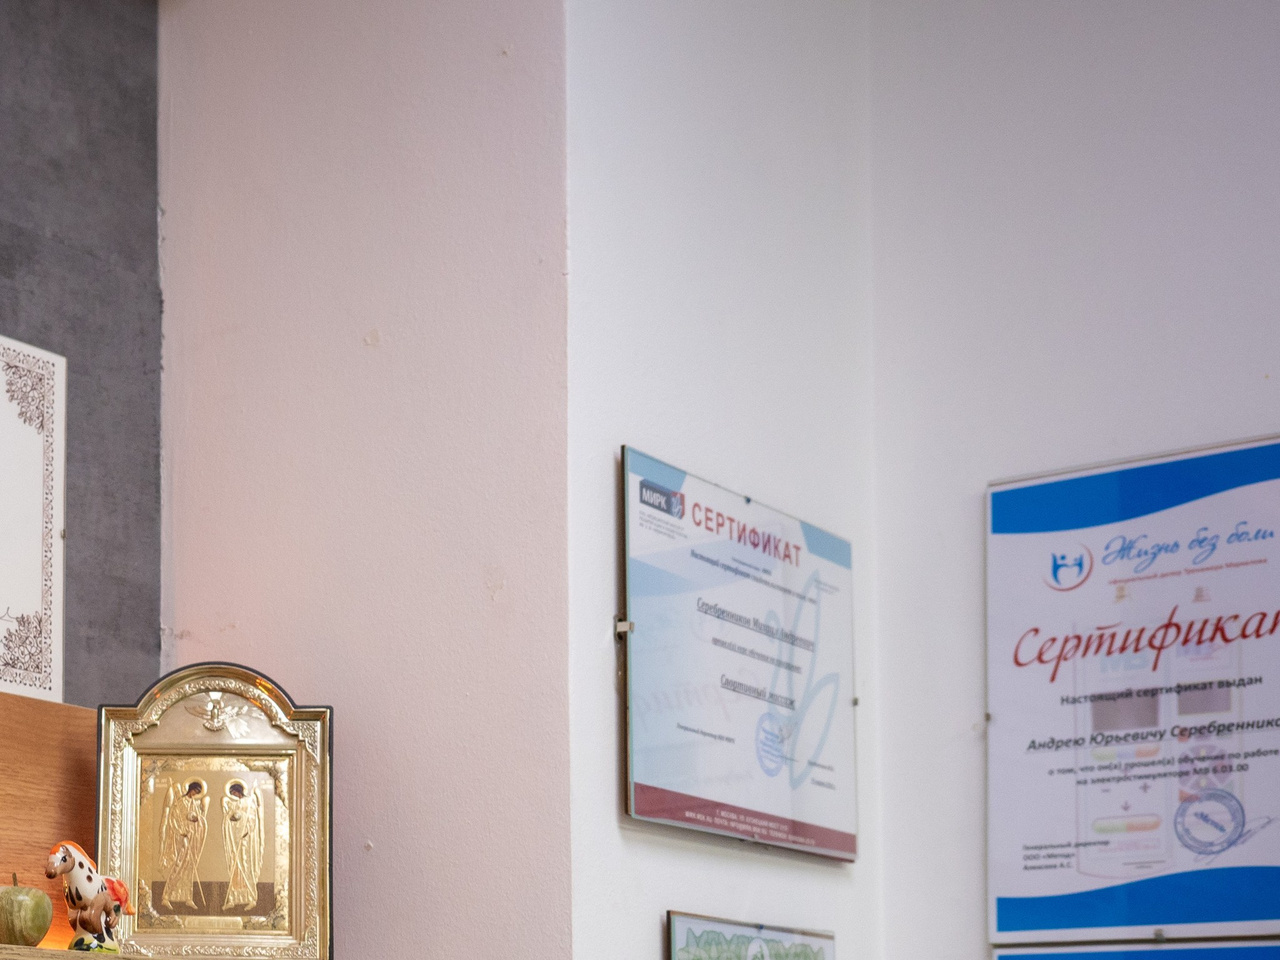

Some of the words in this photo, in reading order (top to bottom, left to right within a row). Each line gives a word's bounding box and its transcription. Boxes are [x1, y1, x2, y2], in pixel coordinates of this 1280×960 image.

[642, 487, 668, 511] МИРК
[691, 502, 802, 568] СЕРТИФИКАТ
[1101, 534, 1180, 574] Жизнь
[1188, 527, 1220, 566] без
[1013, 605, 1280, 683] Сертифика
[1060, 688, 1133, 706] Настоящий
[1136, 681, 1215, 699] сертификат
[1217, 675, 1262, 692] выдан
[1027, 734, 1085, 752] Андрею
[1089, 728, 1167, 746] Юрьевичу
